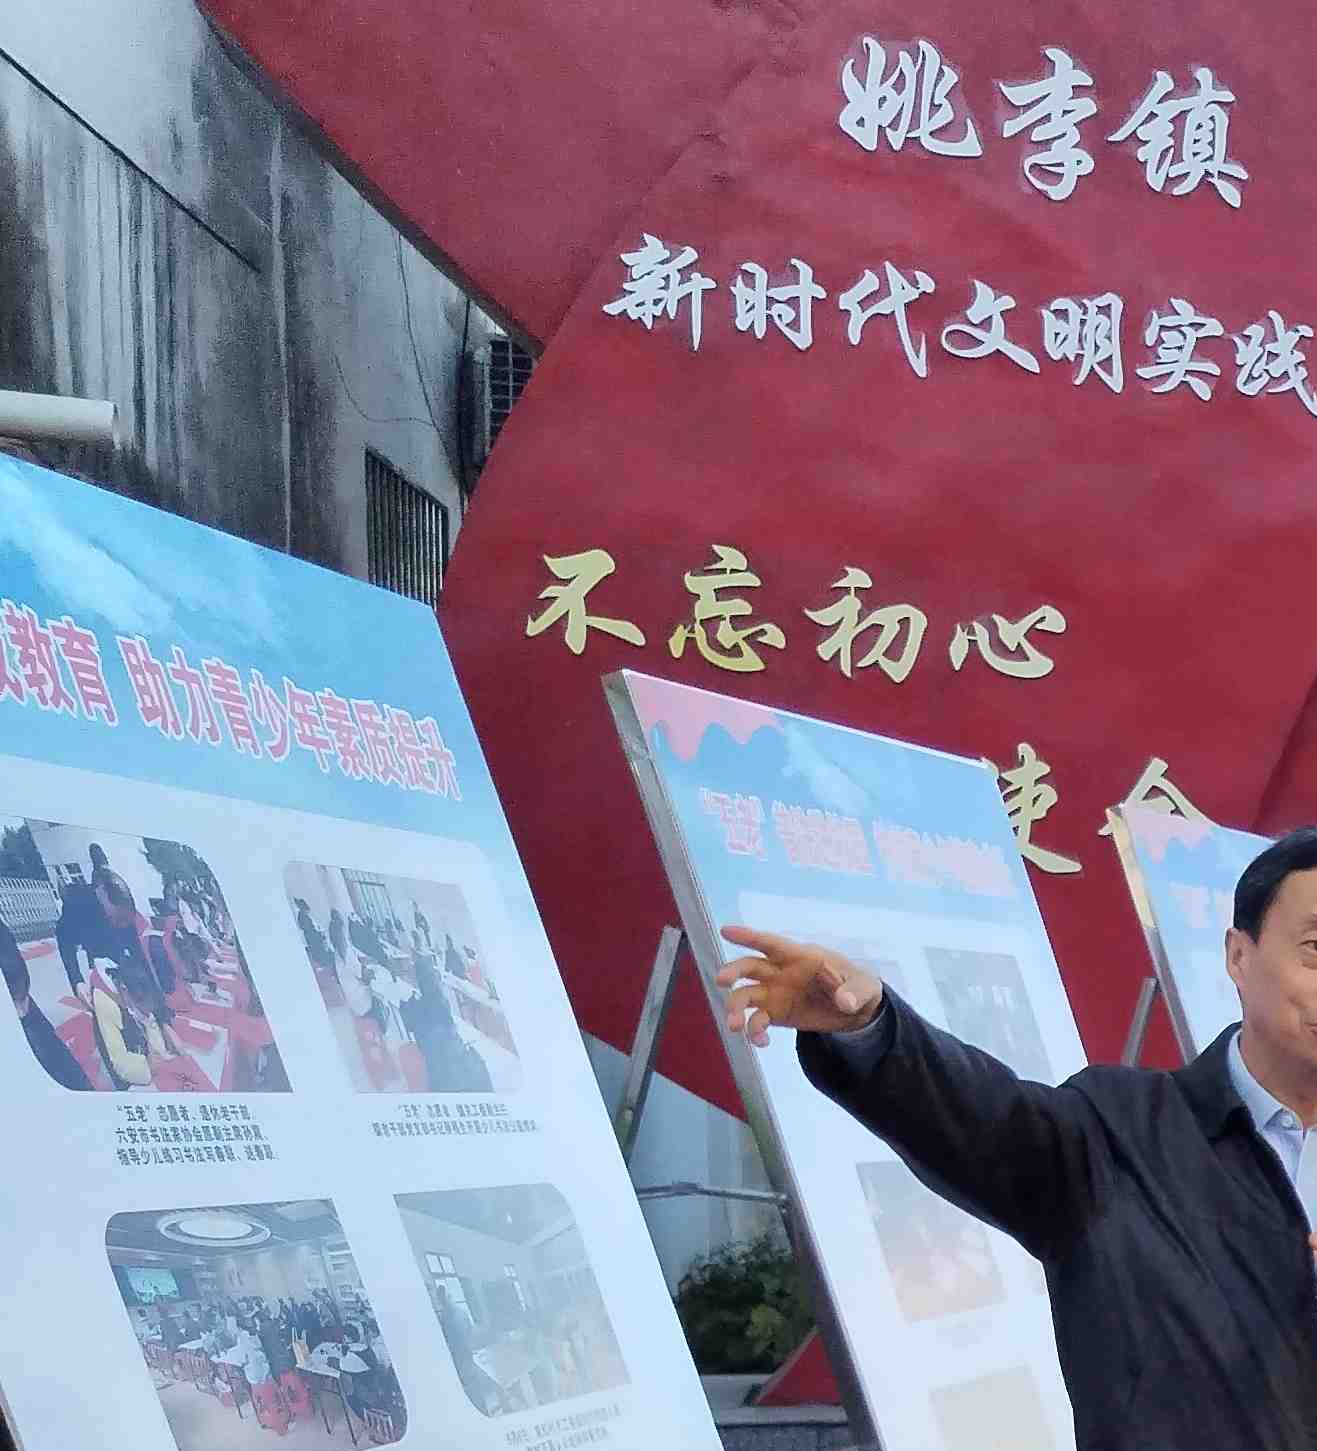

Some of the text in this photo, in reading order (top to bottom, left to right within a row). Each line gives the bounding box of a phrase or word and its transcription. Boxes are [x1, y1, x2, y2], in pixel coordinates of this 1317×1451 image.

[838, 36, 1248, 208] 姚李镇
[527, 544, 1066, 683] 不忘初心
[113, 634, 461, 800] 助力青少年素质提升
